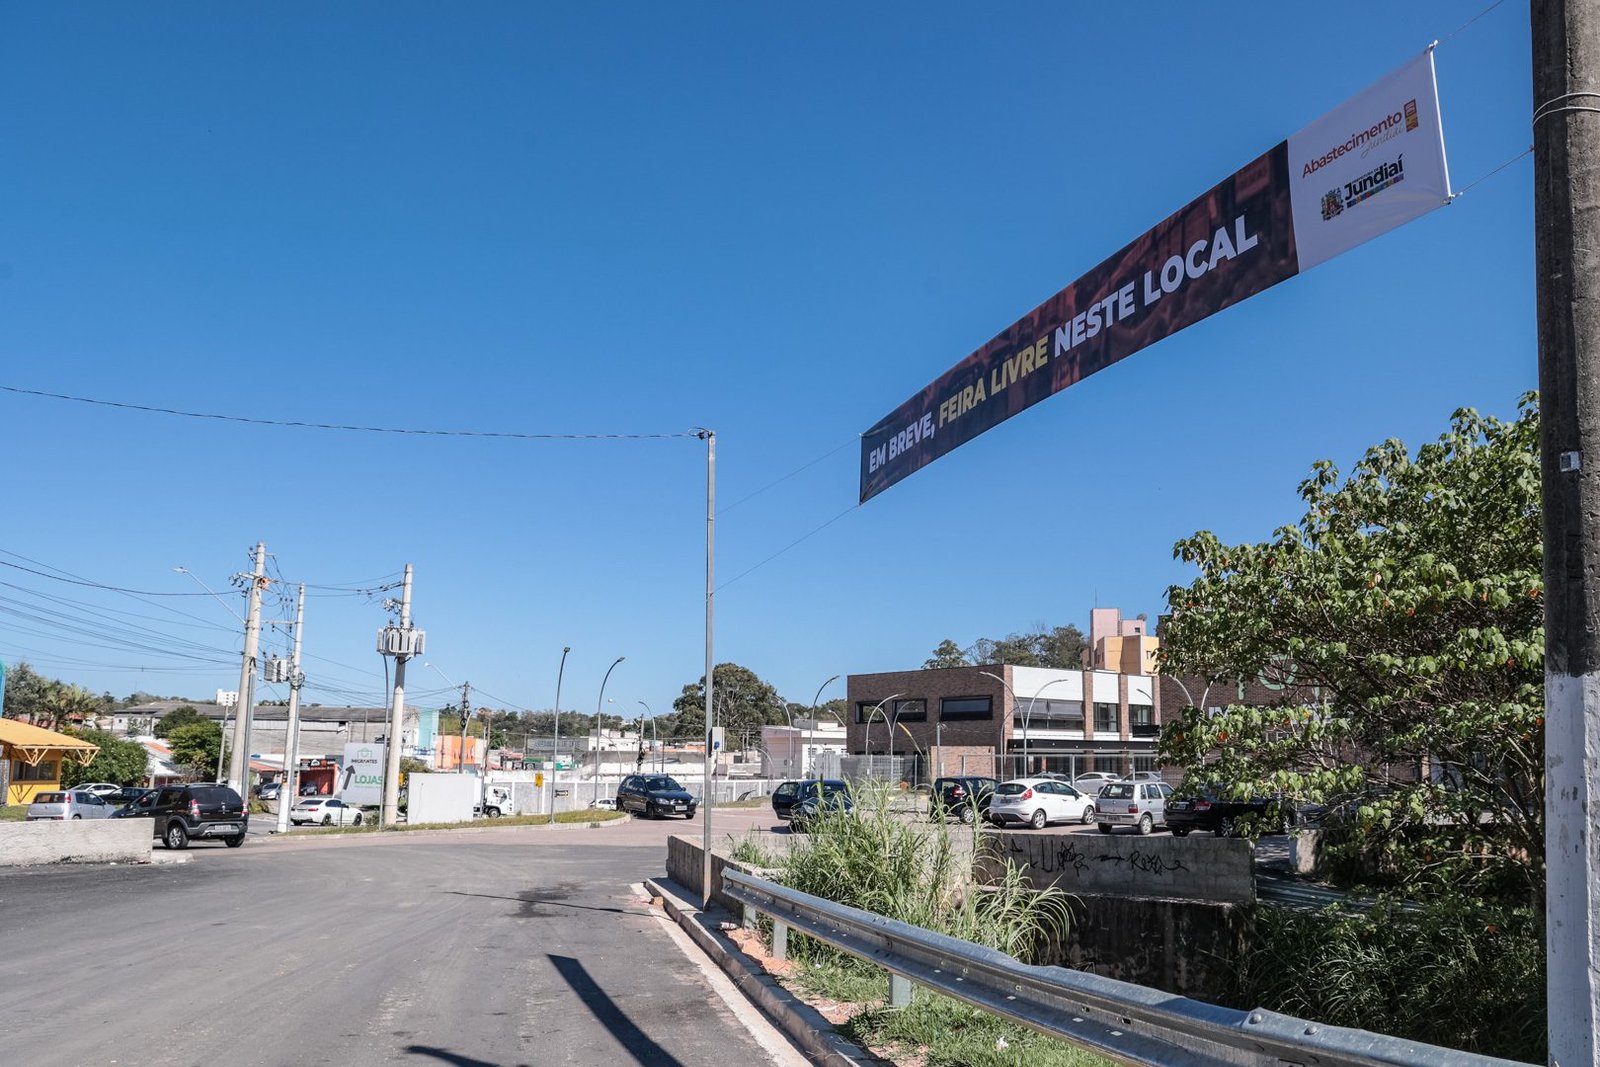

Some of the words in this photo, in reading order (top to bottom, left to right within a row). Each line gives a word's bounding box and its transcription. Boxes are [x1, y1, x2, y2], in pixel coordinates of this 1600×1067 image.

[1302, 112, 1402, 178] Abastecimento
[1344, 154, 1404, 201] Jundiaí
[869, 441, 887, 474] EM
[889, 411, 936, 461] BREVE,
[939, 377, 987, 429] FEIRA
[990, 334, 1049, 396] LIVRE
[1054, 280, 1136, 358] NESTE
[1144, 214, 1259, 306] LOCAL
[354, 775, 383, 785] LOJAS
